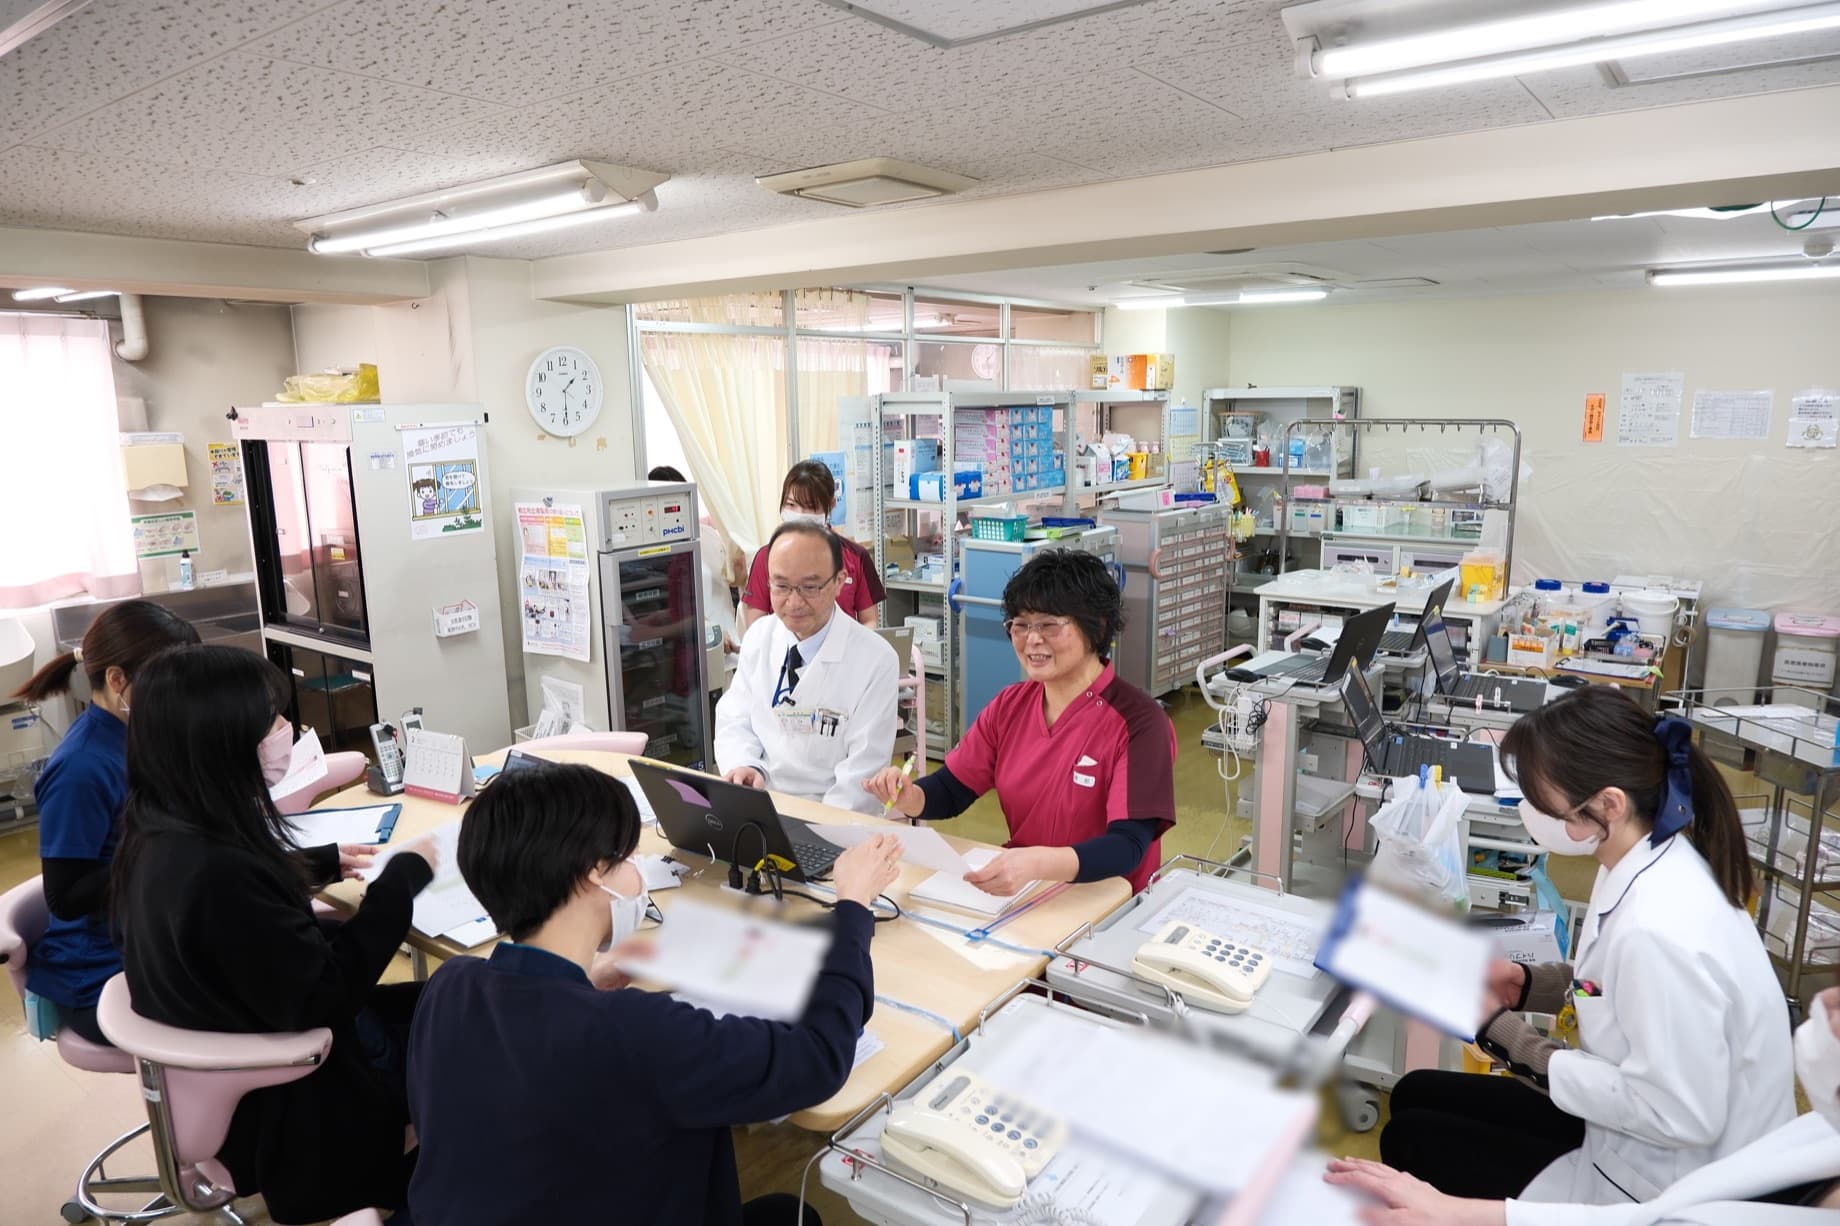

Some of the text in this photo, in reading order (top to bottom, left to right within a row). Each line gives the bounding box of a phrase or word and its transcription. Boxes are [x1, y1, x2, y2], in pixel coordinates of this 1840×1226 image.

[547, 360, 553, 371] 11
[559, 356, 567, 367] 12
[573, 360, 577, 370] 1
[538, 372, 546, 382] 10
[582, 370, 588, 380] 2
[536, 387, 542, 398] 9
[586, 384, 592, 395] 3
[541, 402, 546, 412] 8
[583, 399, 587, 409] 4
[550, 413, 556, 423] 7
[576, 411, 581, 421] 5
